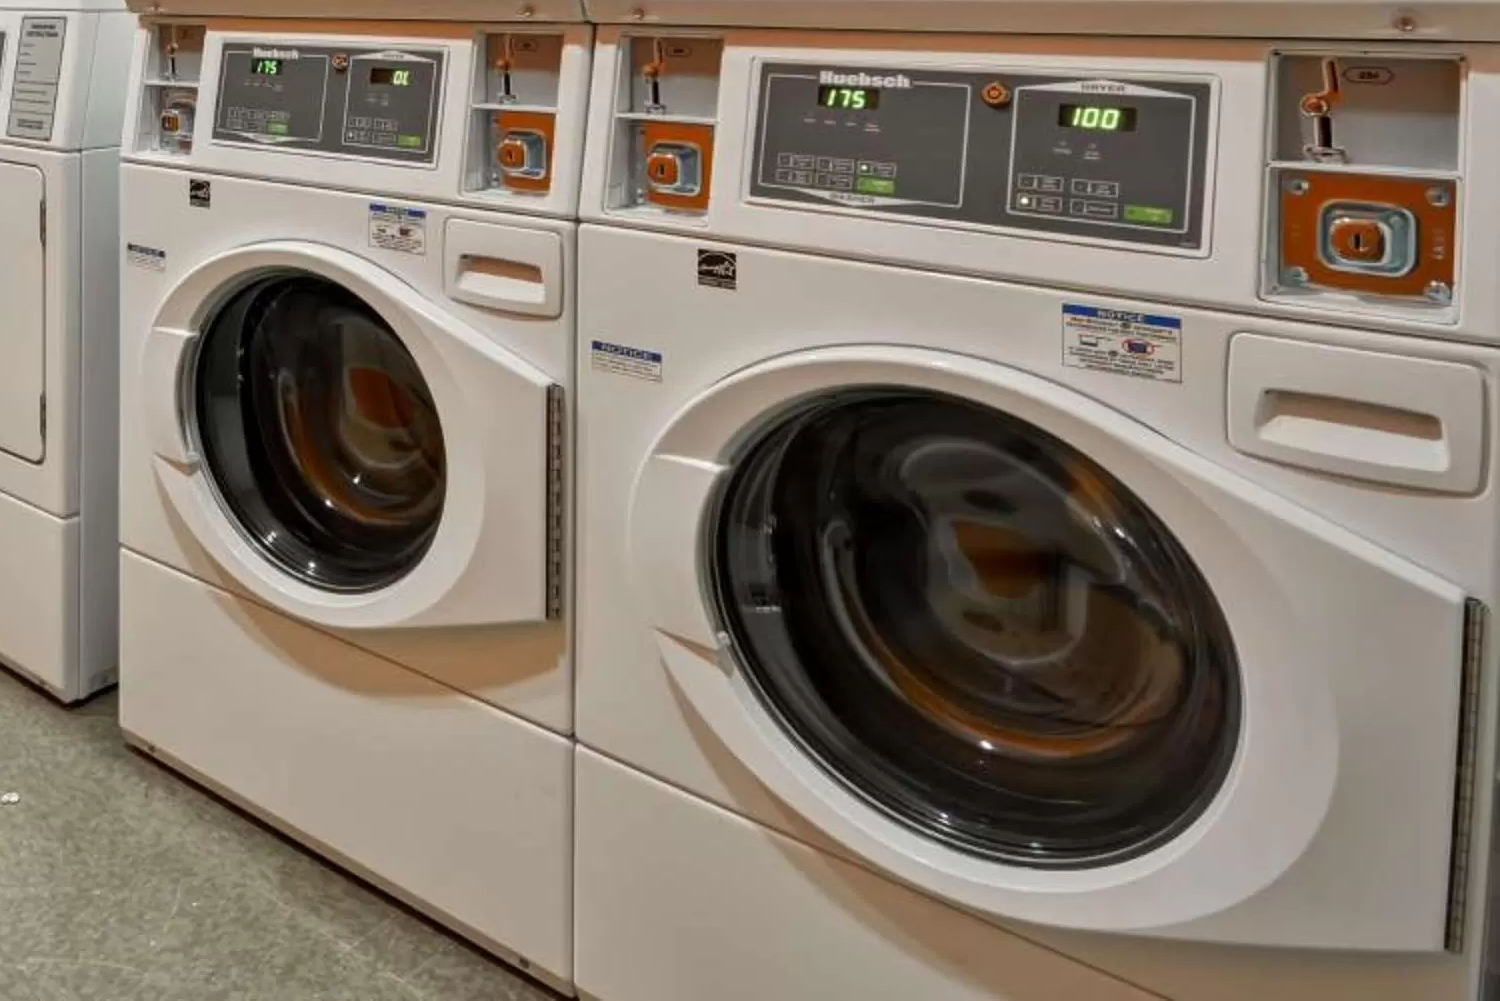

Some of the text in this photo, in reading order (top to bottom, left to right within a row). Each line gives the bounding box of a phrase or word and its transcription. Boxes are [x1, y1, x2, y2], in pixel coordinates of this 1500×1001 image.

[257, 60, 277, 75] 175
[820, 70, 911, 89] Huebsch
[1081, 83, 1126, 93] DRYER
[827, 88, 867, 109] 175
[1072, 107, 1121, 130] 100
